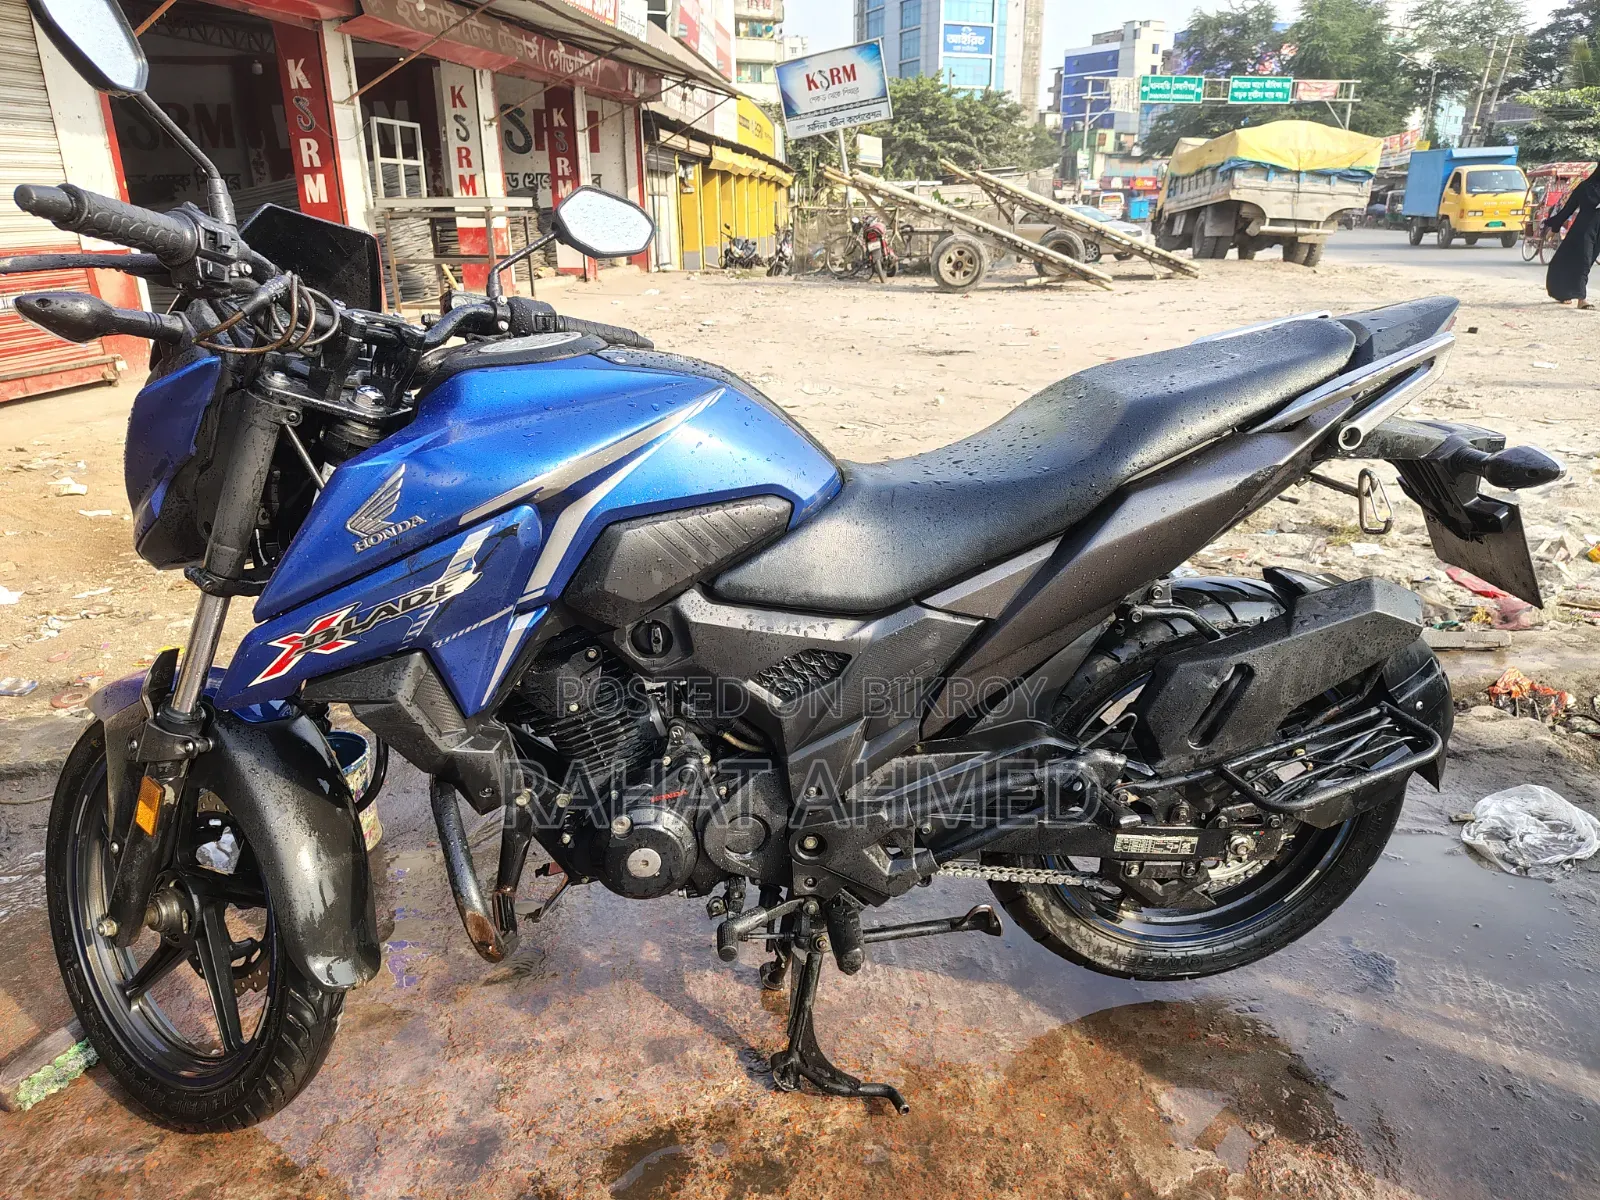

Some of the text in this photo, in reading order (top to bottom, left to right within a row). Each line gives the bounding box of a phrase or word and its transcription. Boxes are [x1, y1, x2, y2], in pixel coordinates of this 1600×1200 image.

[805, 63, 857, 91] KSRM
[287, 58, 328, 204] KSRM
[450, 85, 478, 197] KSRM
[553, 108, 574, 198] KSRM
[352, 515, 427, 553] HONDA
